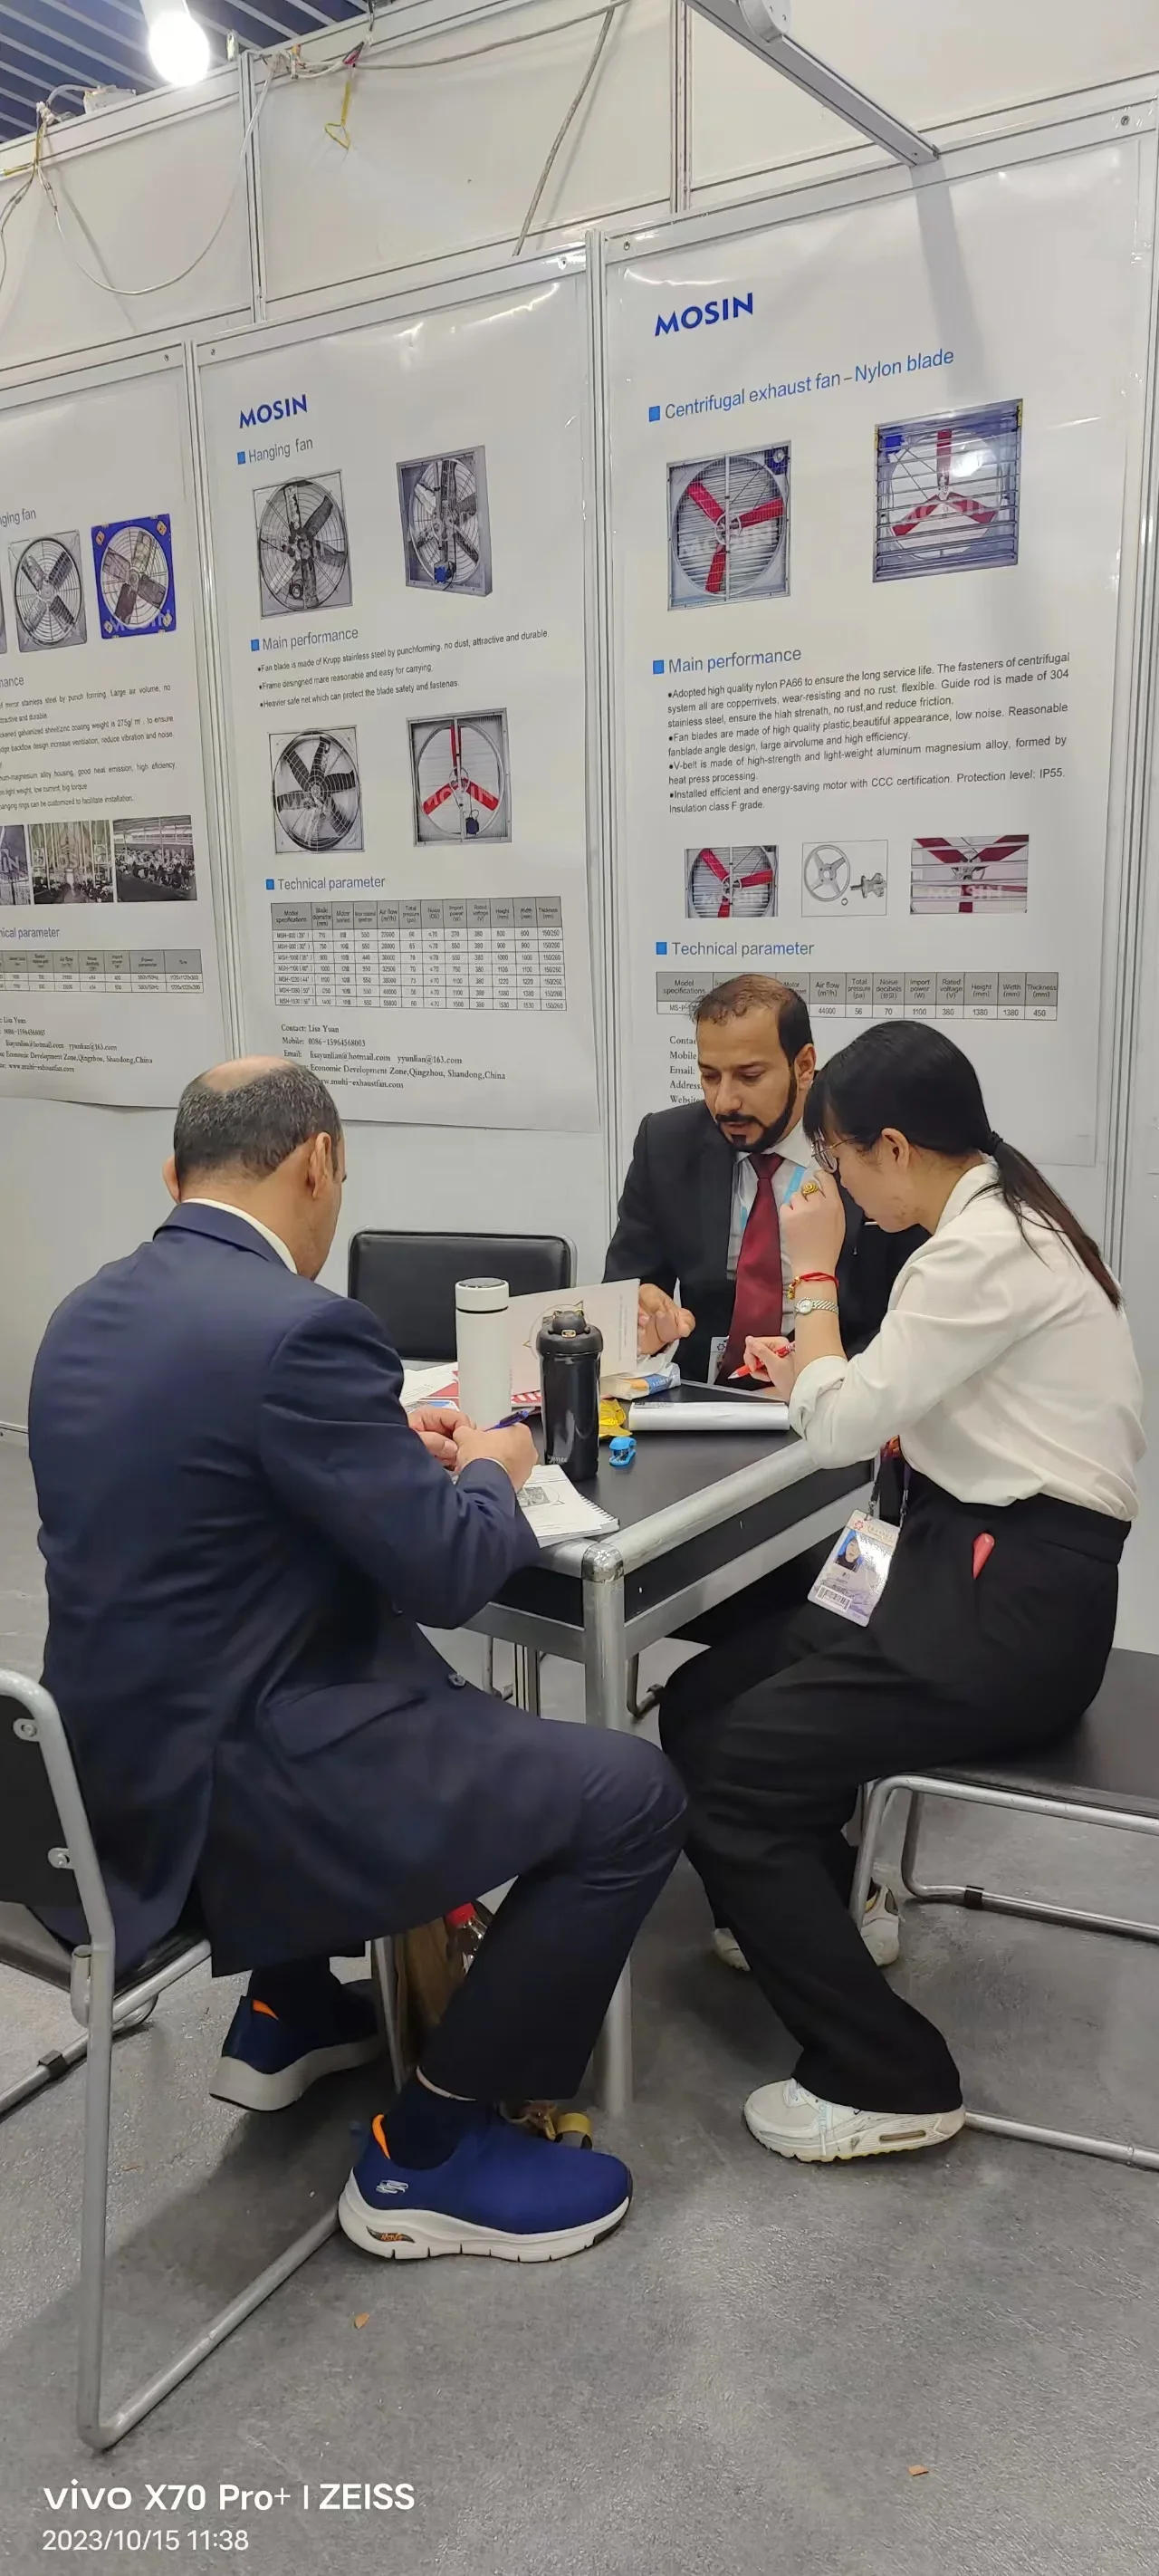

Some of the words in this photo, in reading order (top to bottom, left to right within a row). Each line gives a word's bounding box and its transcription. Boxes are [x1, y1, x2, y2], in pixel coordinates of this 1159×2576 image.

[654, 292, 752, 337] MOSIN
[665, 388, 744, 418] Centrifugal
[749, 376, 811, 402] exhaust
[814, 371, 840, 389] fan
[855, 360, 901, 384] Nylon
[906, 347, 953, 371] blade
[238, 393, 307, 428] MOSIN
[248, 443, 290, 463] Hanging
[294, 437, 313, 453] fan
[21, 507, 36, 521] fan
[262, 635, 288, 650] Main
[290, 628, 359, 650] performance
[273, 661, 290, 671] blade
[297, 658, 314, 668] made
[315, 657, 321, 666] of
[342, 652, 369, 662] stainless
[370, 649, 386, 658] steel
[387, 649, 396, 658] by
[444, 641, 453, 649] no
[454, 639, 471, 649] dust,
[472, 634, 504, 646] attractive
[505, 631, 519, 642] and
[668, 656, 703, 674] Main
[707, 649, 801, 673] performance
[707, 685, 724, 697] high
[726, 682, 753, 695] quality
[754, 680, 778, 692] nylon
[779, 677, 802, 688] PA66
[804, 677, 812, 686] to
[814, 675, 844, 685] ensure
[845, 671, 859, 682] the
[861, 670, 880, 681] long
[882, 667, 915, 678] service
[917, 664, 934, 675] life.
[936, 663, 956, 673] The
[957, 659, 1003, 671] fasteners
[1005, 656, 1016, 668] of
[1017, 651, 1069, 667] centrifugal
[666, 703, 695, 716] system
[698, 701, 707, 711] all
[710, 701, 723, 710] are
[781, 689, 841, 703] wear-resisting
[843, 687, 860, 697] and
[863, 687, 875, 696] no
[940, 677, 970, 689] Guide
[973, 675, 990, 687] rod
[992, 674, 1001, 685] is
[1004, 671, 1033, 684] made
[1036, 669, 1047, 681] of
[1049, 668, 1068, 680] 304
[691, 729, 717, 741] blades
[720, 730, 733, 738] are
[735, 726, 759, 737] made
[761, 725, 771, 735] of
[771, 724, 790, 736] high
[792, 721, 820, 735] quality
[893, 713, 952, 726] appearance,
[955, 710, 972, 720] low
[974, 707, 1004, 718] noise.
[1008, 702, 1068, 716] Reasonable
[667, 745, 703, 756] fanblade
[704, 743, 726, 755] angle
[760, 740, 781, 752] large
[782, 737, 824, 748] airvolume
[825, 735, 842, 745] and
[844, 733, 863, 745] high
[865, 731, 910, 742] efficiency.
[700, 759, 707, 768] is
[710, 756, 733, 768] made
[735, 755, 744, 766] of
[747, 753, 800, 767] high-strength
[804, 751, 820, 761] and
[823, 747, 873, 762] light-weight
[876, 745, 921, 756] aluminum
[924, 741, 981, 755] magnesium
[1015, 735, 1050, 747] formed
[1054, 735, 1067, 746] by
[668, 774, 686, 785] heat
[687, 774, 710, 785] press
[709, 785, 741, 797] efficient
[742, 784, 759, 794] and
[761, 782, 819, 795] energy-saving
[822, 780, 848, 790] motor
[849, 778, 867, 788] with
[870, 776, 893, 787] CCC
[896, 774, 953, 786] certification.
[956, 771, 1005, 783] Protection
[1009, 768, 1035, 780] level:
[669, 803, 707, 813] Insulation
[708, 802, 729, 812] class
[731, 800, 737, 811] F
[276, 876, 326, 890] Technical
[328, 875, 386, 891] parameter
[17, 927, 60, 940] parameter
[671, 941, 737, 956] Technical
[741, 941, 814, 957] parameter
[674, 979, 694, 987] Model
[815, 981, 825, 989] Air
[825, 981, 840, 989] flow
[971, 984, 991, 992] Height
[1026, 984, 1057, 992] Thickness
[818, 1006, 836, 1014] 44000
[884, 1007, 893, 1015] 70
[912, 1007, 926, 1015] 1100
[941, 1007, 954, 1016] 380
[1002, 1008, 1019, 1016] 1380
[1032, 1008, 1046, 1016] 450
[280, 1023, 306, 1032] Contact:
[307, 1024, 321, 1033] Lisa
[321, 1024, 339, 1033] Yuan
